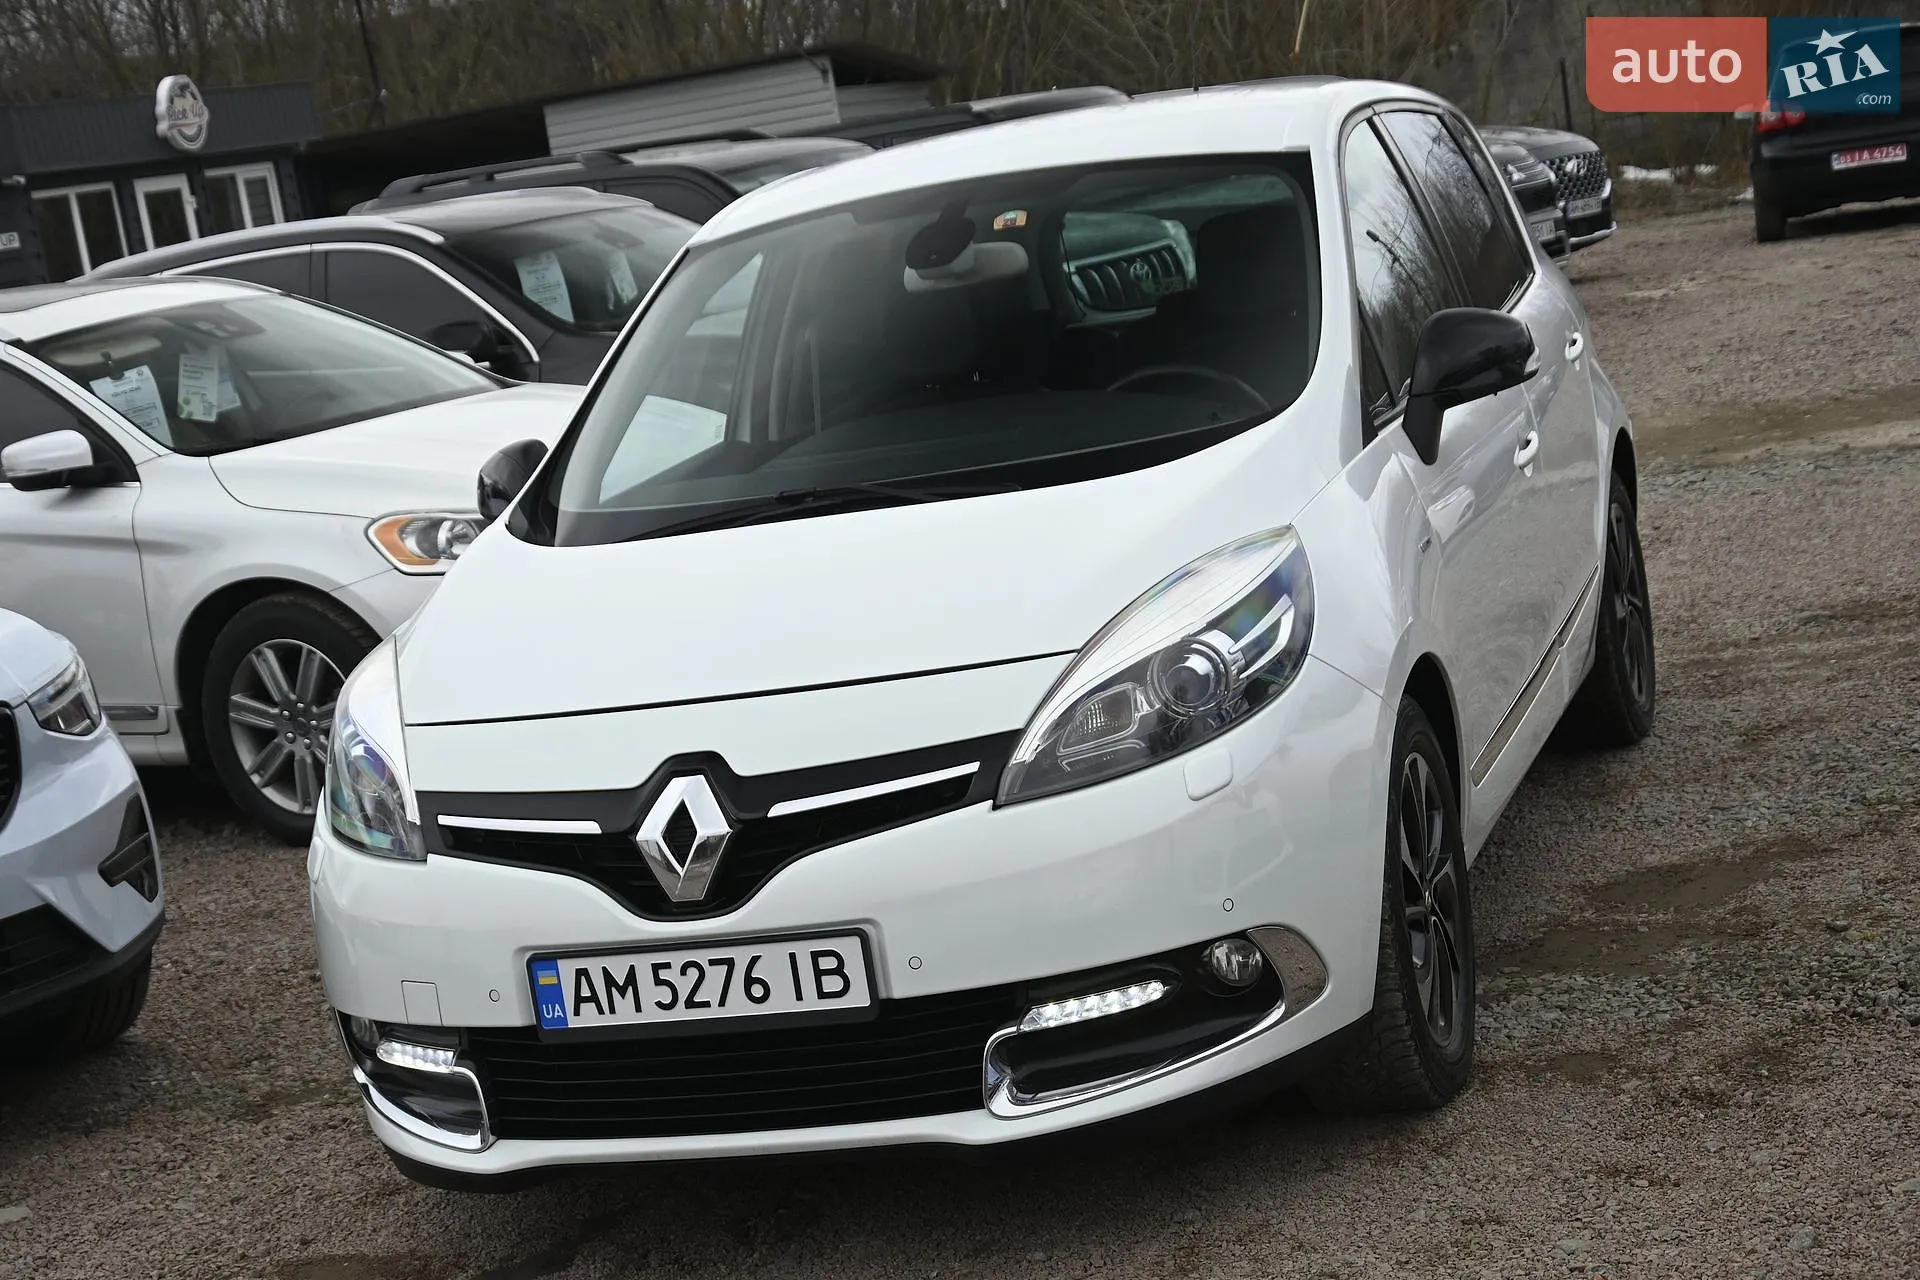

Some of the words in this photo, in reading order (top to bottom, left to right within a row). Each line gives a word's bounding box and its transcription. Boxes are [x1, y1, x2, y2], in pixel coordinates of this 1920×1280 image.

[573, 964, 643, 1018] AM
[650, 954, 771, 1011] 5276
[788, 949, 851, 1002] IB
[542, 1004, 565, 1019] UA
